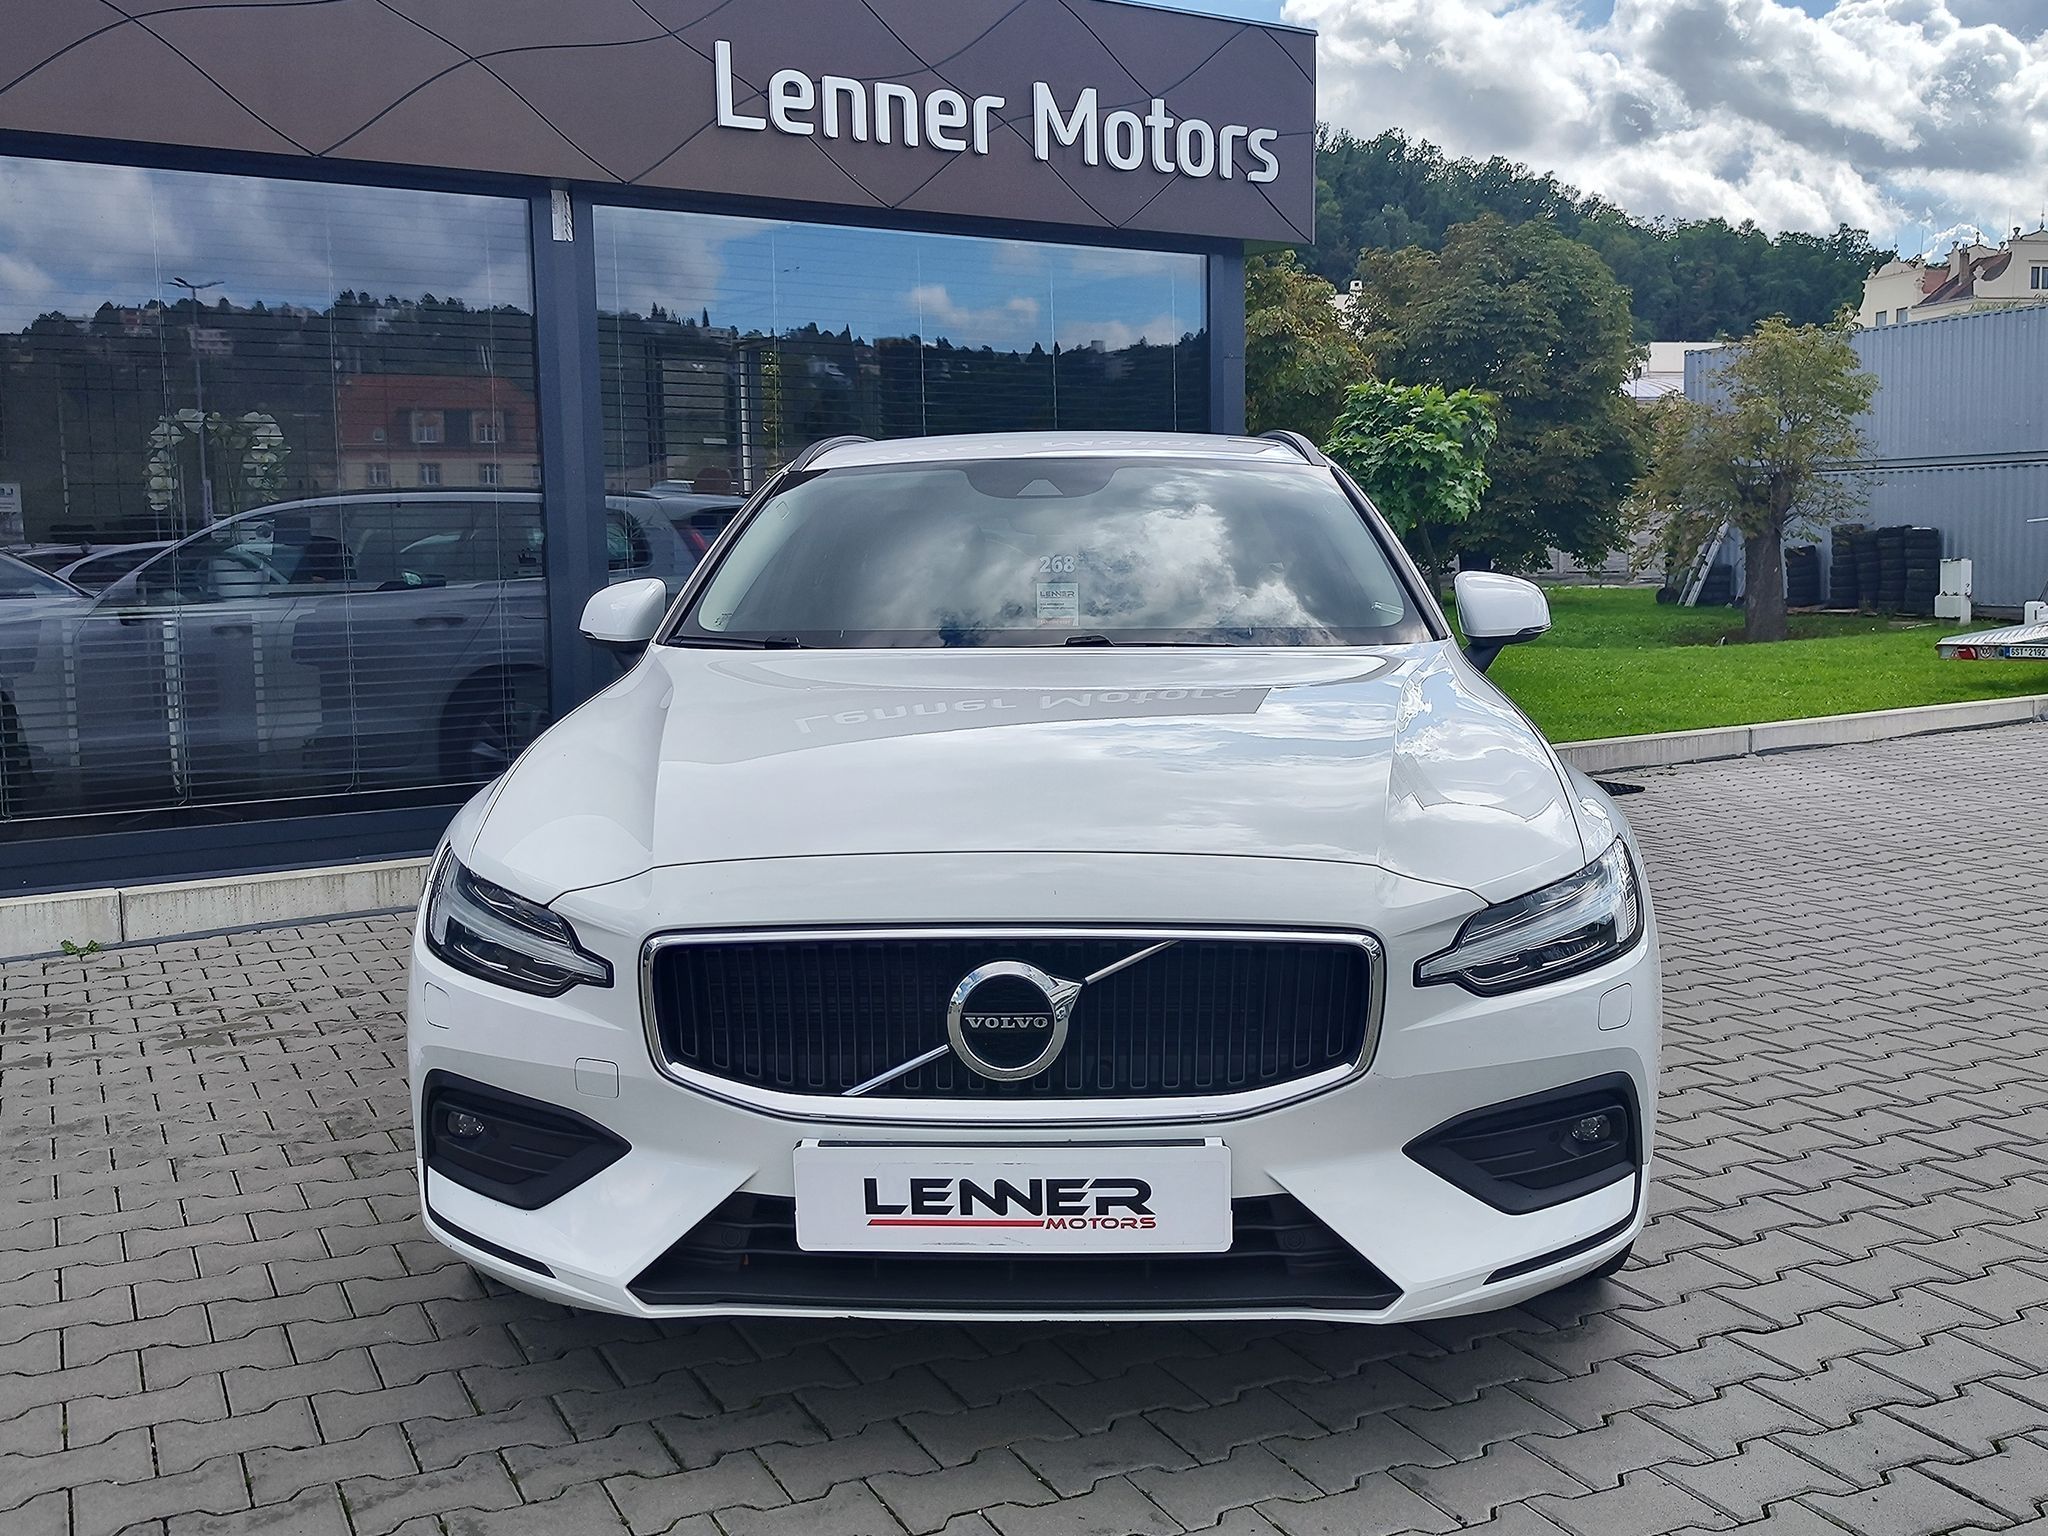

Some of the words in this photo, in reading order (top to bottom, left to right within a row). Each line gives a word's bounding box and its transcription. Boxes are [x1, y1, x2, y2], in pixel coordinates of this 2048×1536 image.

[713, 39, 1006, 156] Lenner
[1033, 81, 1279, 184] Motors
[1038, 555, 1076, 573] 268
[965, 1016, 1048, 1029] VOLVO
[863, 1177, 1154, 1217] LENNER
[1044, 1216, 1157, 1231] MOTORS
